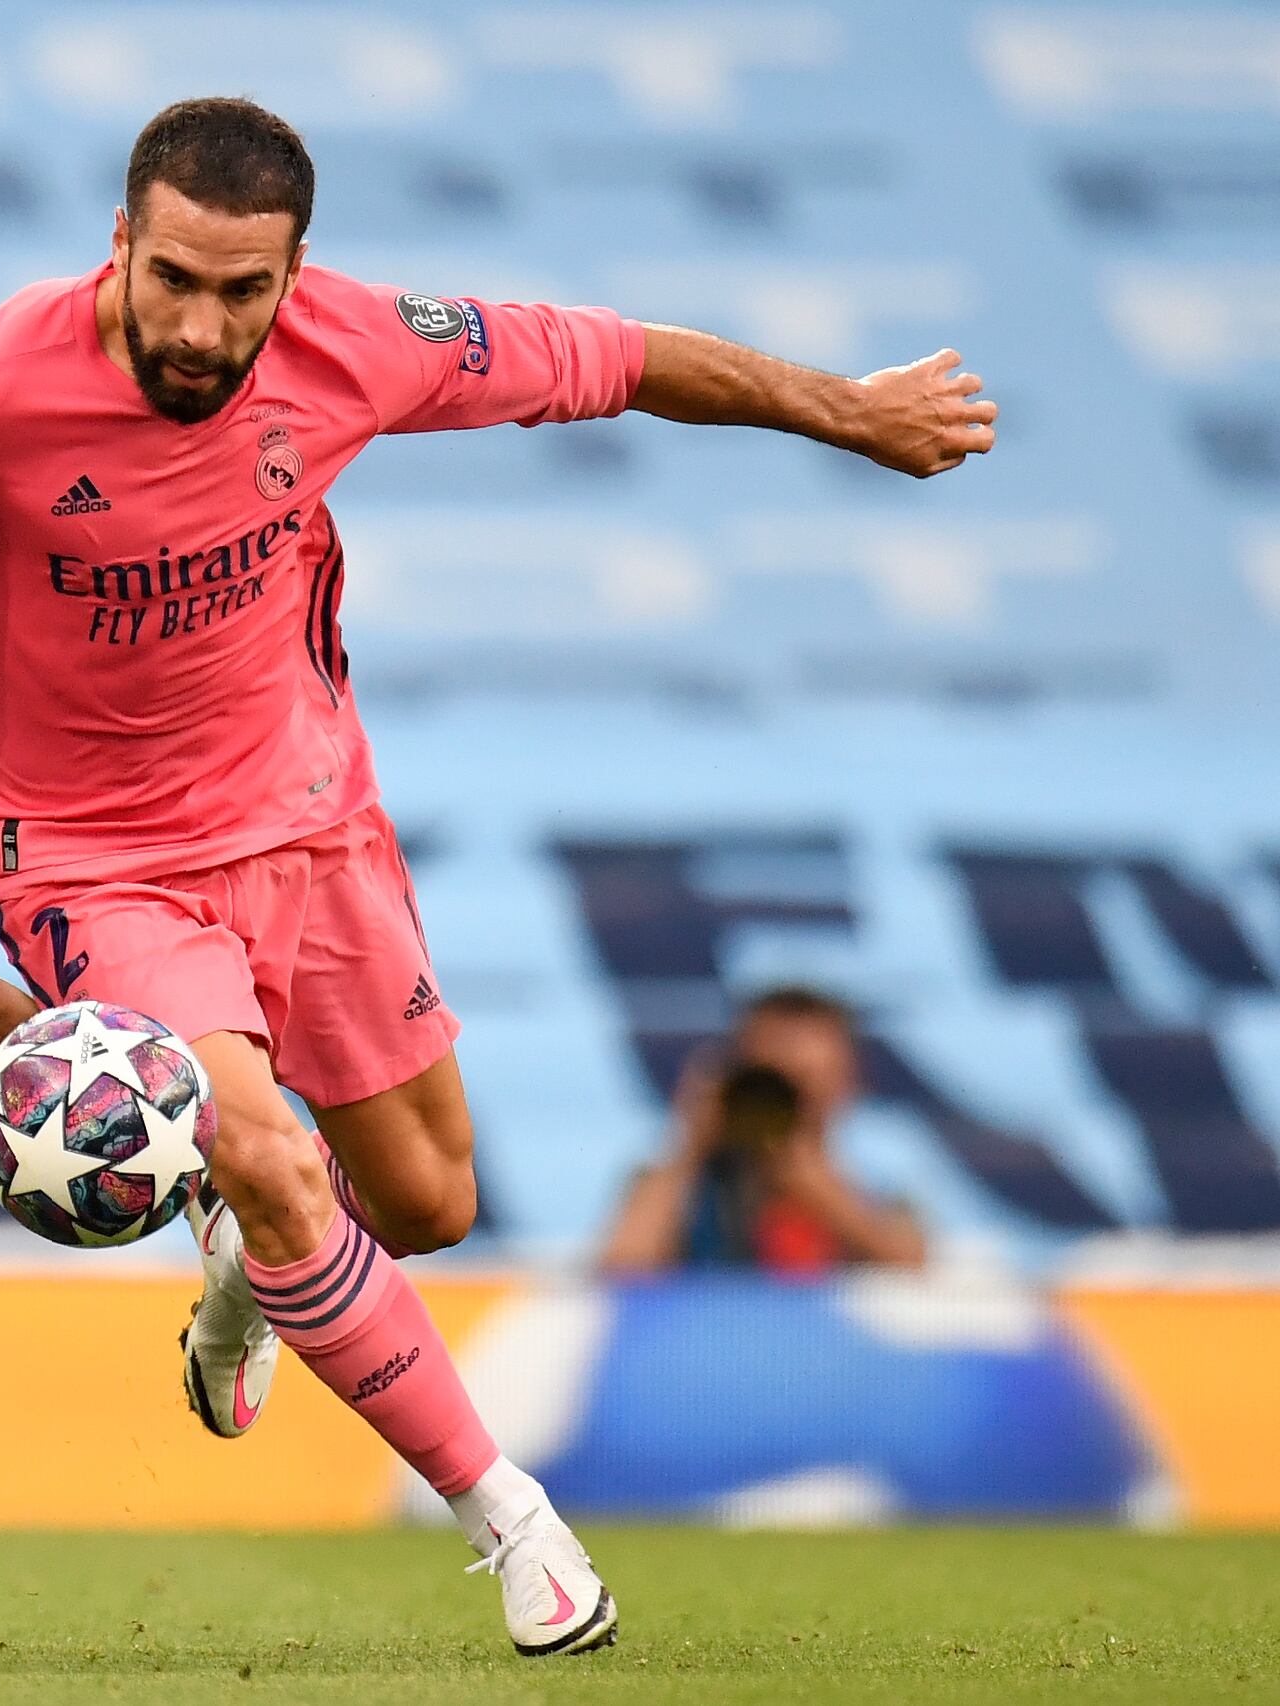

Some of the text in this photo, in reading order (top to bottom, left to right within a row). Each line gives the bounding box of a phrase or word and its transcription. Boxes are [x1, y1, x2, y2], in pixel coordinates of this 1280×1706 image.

[249, 402, 292, 423] Gracias
[51, 498, 112, 516] adidas
[47, 509, 302, 601] Emirates
[89, 571, 265, 646] FLY BETTER
[30, 907, 90, 999] 2
[80, 1032, 93, 1064] adidas
[351, 1346, 420, 1403] MADRID
[358, 1352, 405, 1391] REAL
